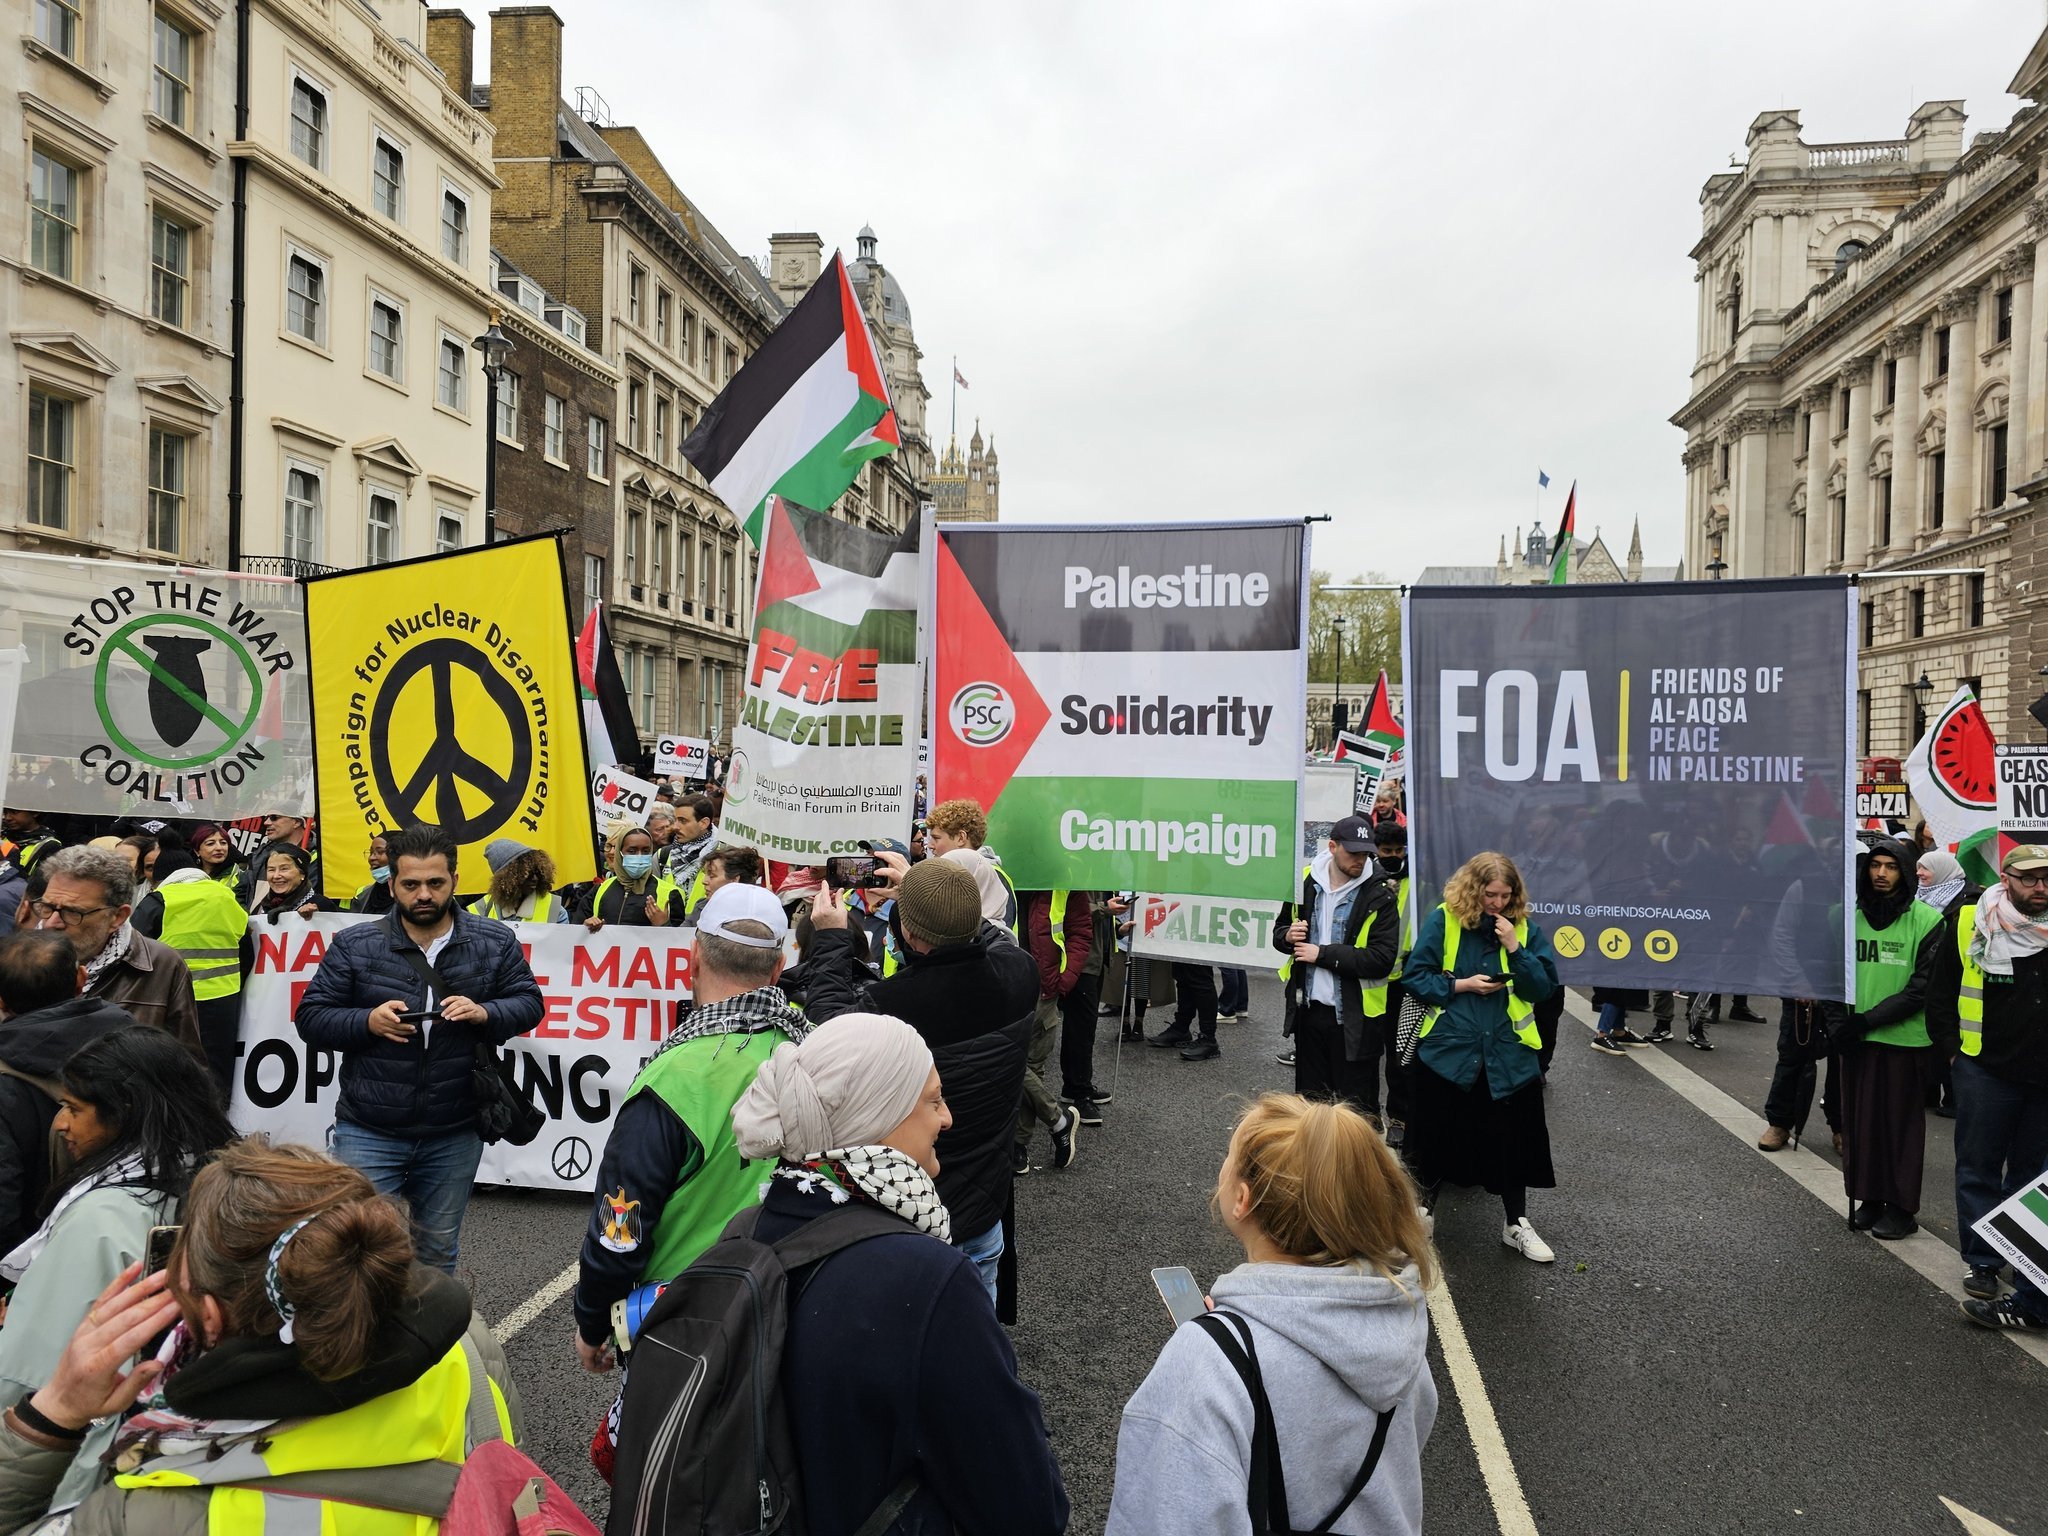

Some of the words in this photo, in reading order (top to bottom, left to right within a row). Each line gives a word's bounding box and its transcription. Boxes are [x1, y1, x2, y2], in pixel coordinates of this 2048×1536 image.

[1064, 564, 1269, 609] Palestine
[64, 586, 135, 656] STOP
[146, 580, 222, 617] THE
[227, 602, 294, 676] WAR
[1651, 667, 1747, 694] FRIENDS
[1755, 666, 1784, 693] OF
[355, 641, 388, 683] for
[386, 603, 481, 645] Nuclear
[485, 622, 549, 833] Disarmament
[964, 705, 1001, 724] PSC
[1060, 694, 1274, 746] Solidarity
[1440, 669, 1601, 782] FOA
[1649, 697, 1748, 726] AL-AQSA
[1650, 727, 1720, 752] PEACE
[80, 742, 265, 802] COALITION
[1649, 756, 1672, 782] IN
[1680, 756, 1804, 782] PALESTINE
[753, 790, 801, 811] Palestinian
[805, 802, 842, 813] Forum
[846, 802, 857, 813] in
[861, 802, 900, 813] Britain
[777, 783, 798, 796] في
[800, 784, 862, 799] الفلسطيني
[863, 785, 902, 798] المنتدى
[1857, 793, 1908, 816] GAZA
[1060, 809, 1276, 866] Campaign
[1144, 897, 1279, 949] PALEST
[1525, 902, 1564, 915] OLLOW
[1567, 904, 1581, 915] US
[1584, 905, 1711, 920] @FRIENDSOFALAQSA
[1856, 939, 1879, 962] OA
[571, 945, 692, 990] MAR
[1981, 1223, 2017, 1256] Campaign
[2016, 1254, 2048, 1285] Solidarity
